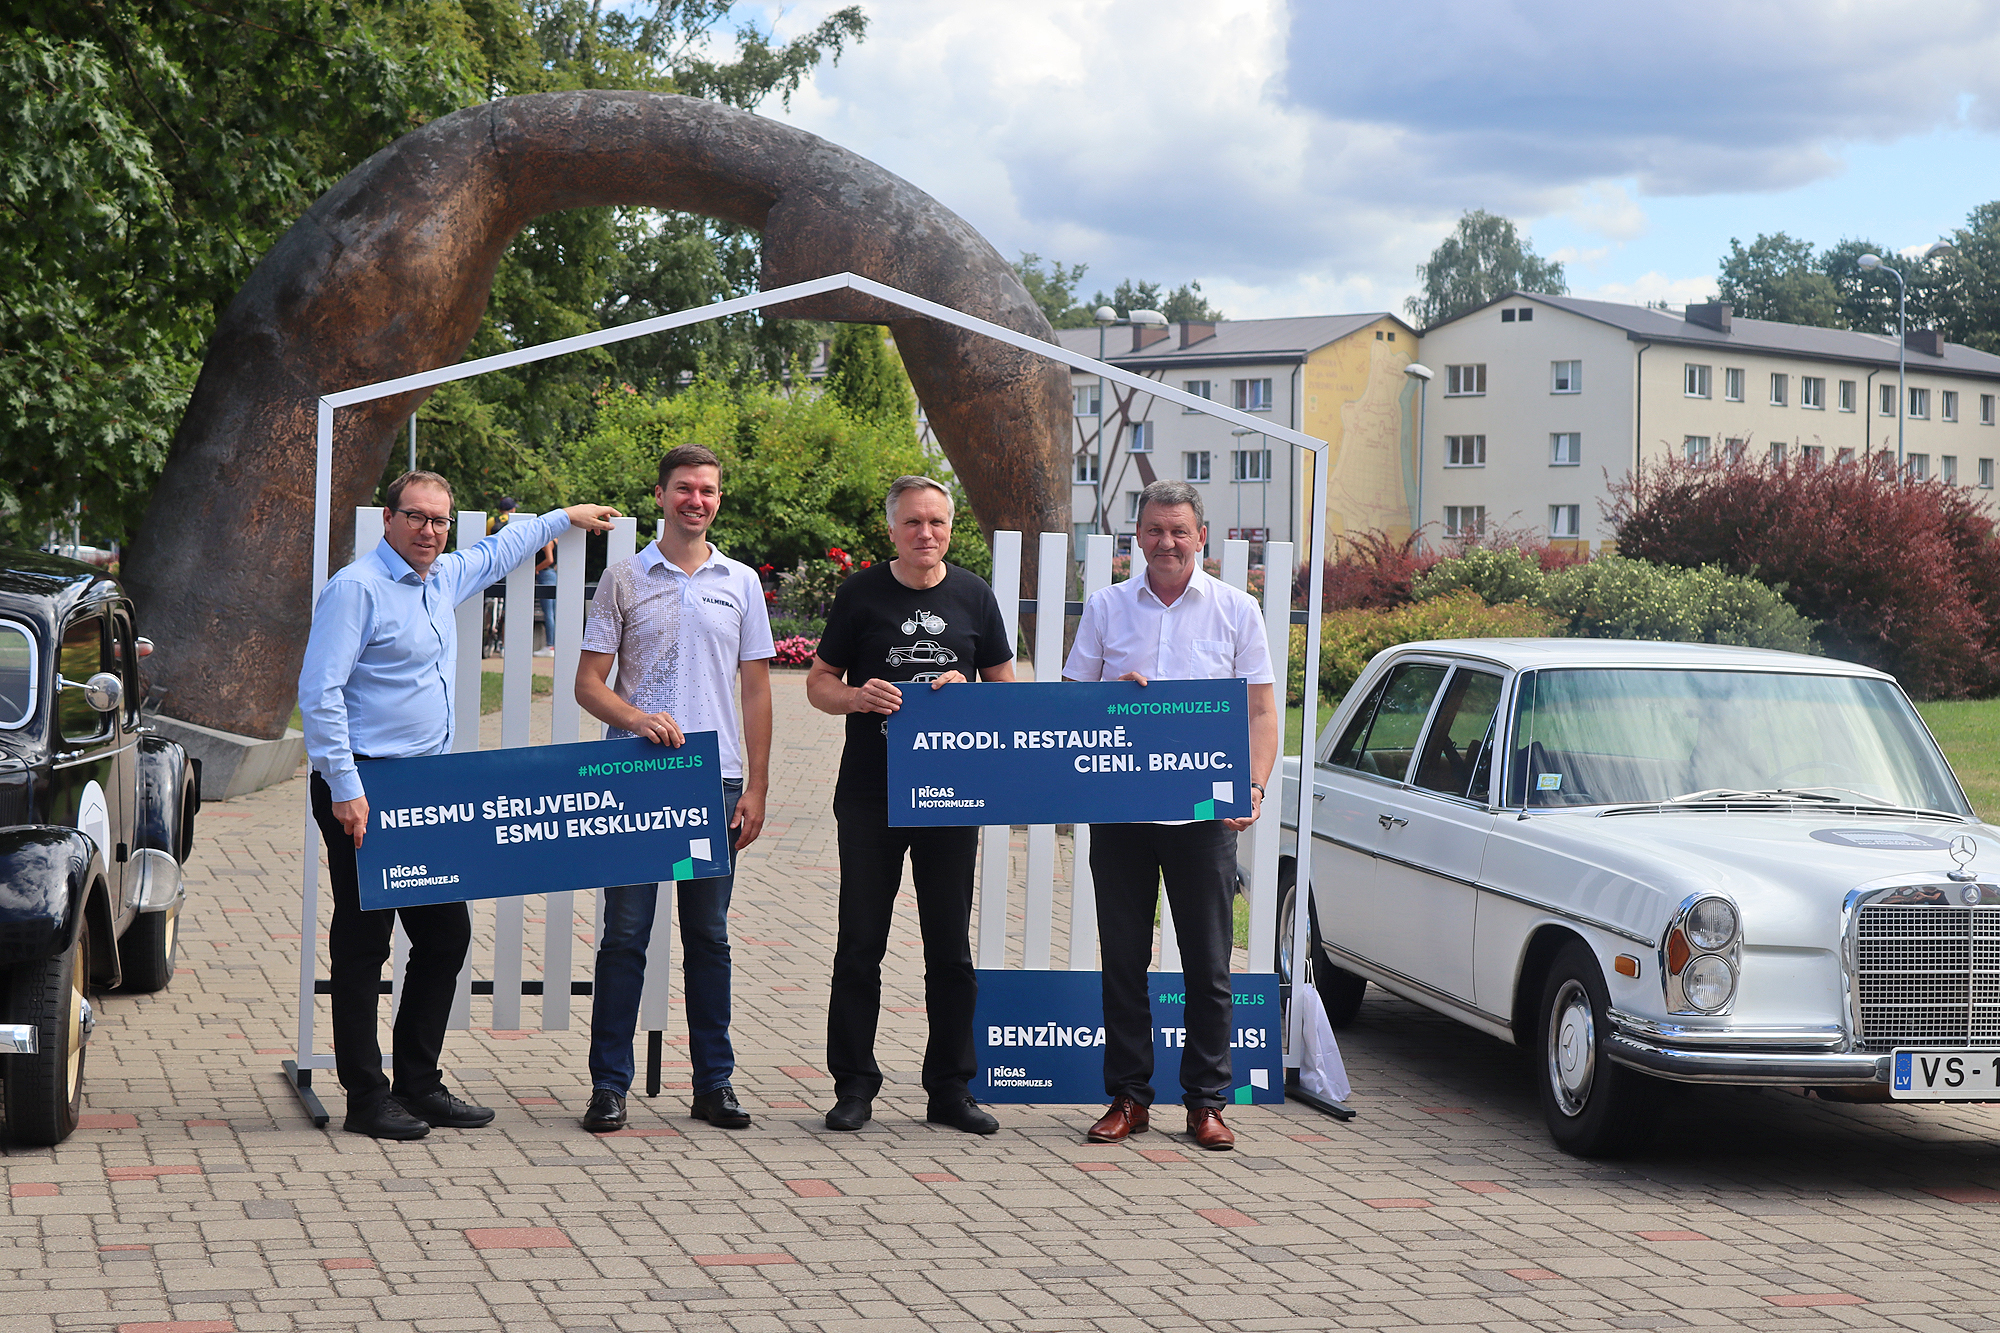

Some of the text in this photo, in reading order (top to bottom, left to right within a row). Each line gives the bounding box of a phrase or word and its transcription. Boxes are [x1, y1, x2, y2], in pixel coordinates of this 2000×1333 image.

[1107, 701, 1231, 716] #MOTORMUZEJS
[912, 725, 1133, 750] ATRODI. RESTAURĒ.
[578, 754, 703, 777] #MOTORMUZEJS
[1074, 751, 1233, 773] CIENI. BRAUC.
[918, 785, 955, 798] RĪGAS
[380, 790, 625, 829] NEESMU SĒRIJVEIDA,
[918, 799, 985, 809] MOTORMUZEJS
[495, 806, 709, 845] ESMU EKSKLUZĪVS!
[389, 864, 428, 878] RĪGAS
[390, 874, 460, 889] MOTORMUZEJS
[1159, 993, 1265, 1005] #MOZEJS
[988, 1021, 1267, 1049] BENZĪNGA TEIS!
[993, 1065, 1026, 1078] RĪGAS
[993, 1079, 1053, 1088] MOTORMUZEJS
[1896, 1076, 1909, 1085] LV
